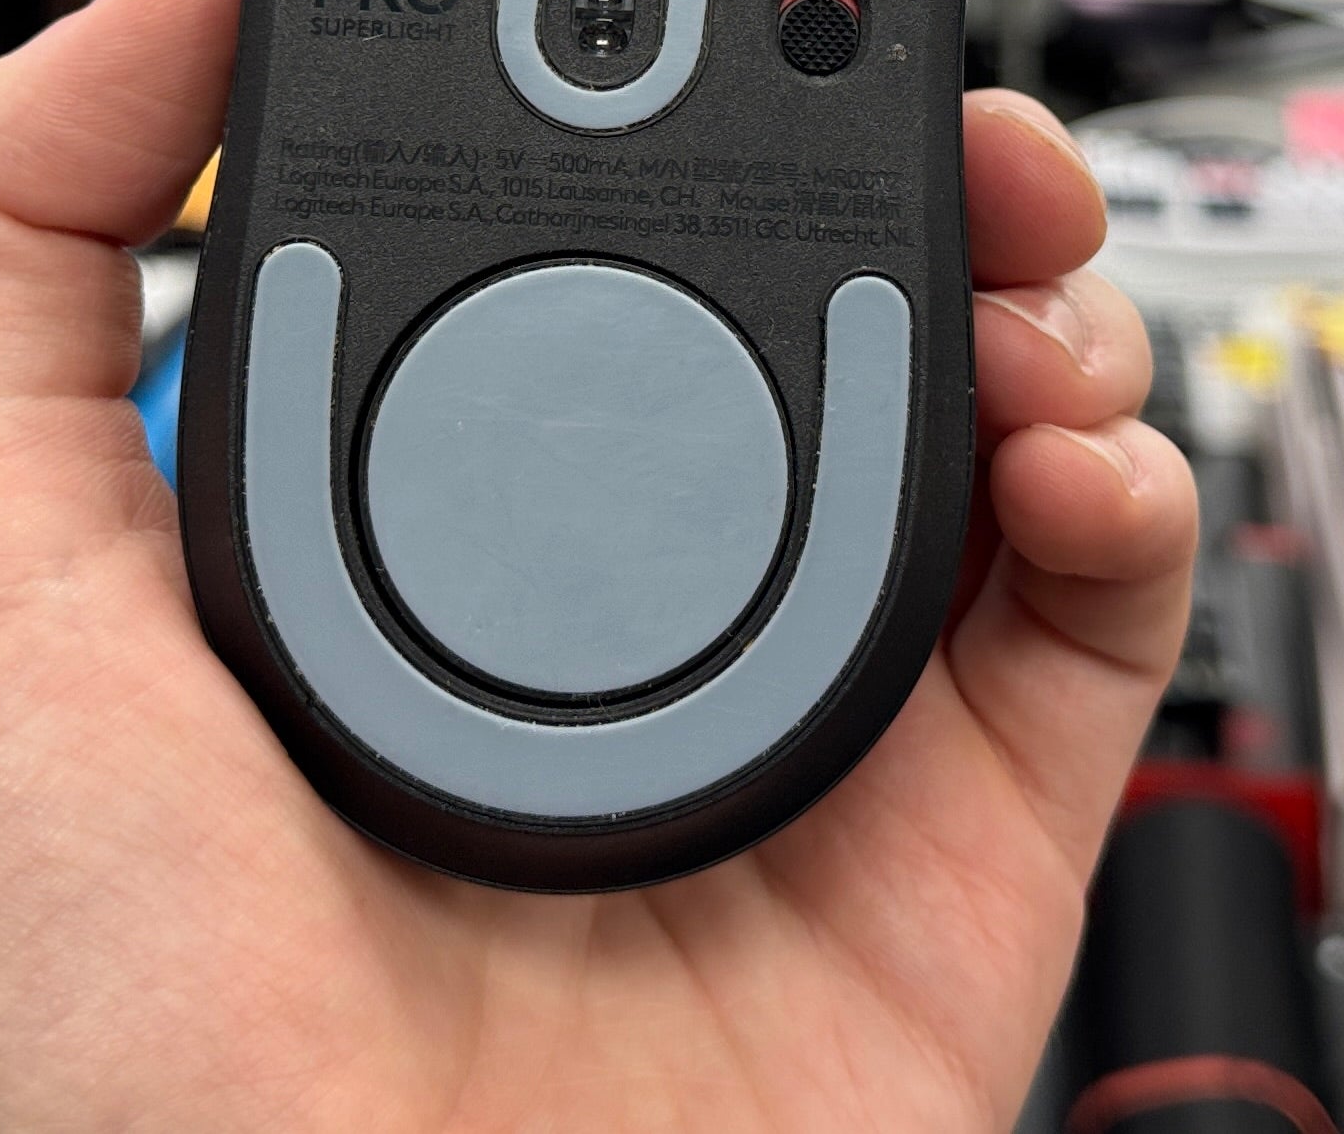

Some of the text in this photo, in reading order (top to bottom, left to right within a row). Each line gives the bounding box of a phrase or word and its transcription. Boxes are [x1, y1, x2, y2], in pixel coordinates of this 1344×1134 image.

[310, 16, 458, 41] SUPERLIGHT
[278, 164, 370, 192] Logitech
[374, 169, 446, 197] Europe
[501, 177, 543, 198] 1015
[548, 180, 653, 207] Lausanne,
[721, 188, 790, 212] Mouse
[274, 192, 364, 219] Logitech
[371, 197, 445, 224] Europe
[496, 204, 668, 237] Catharijnesingel
[756, 219, 791, 241] GC
